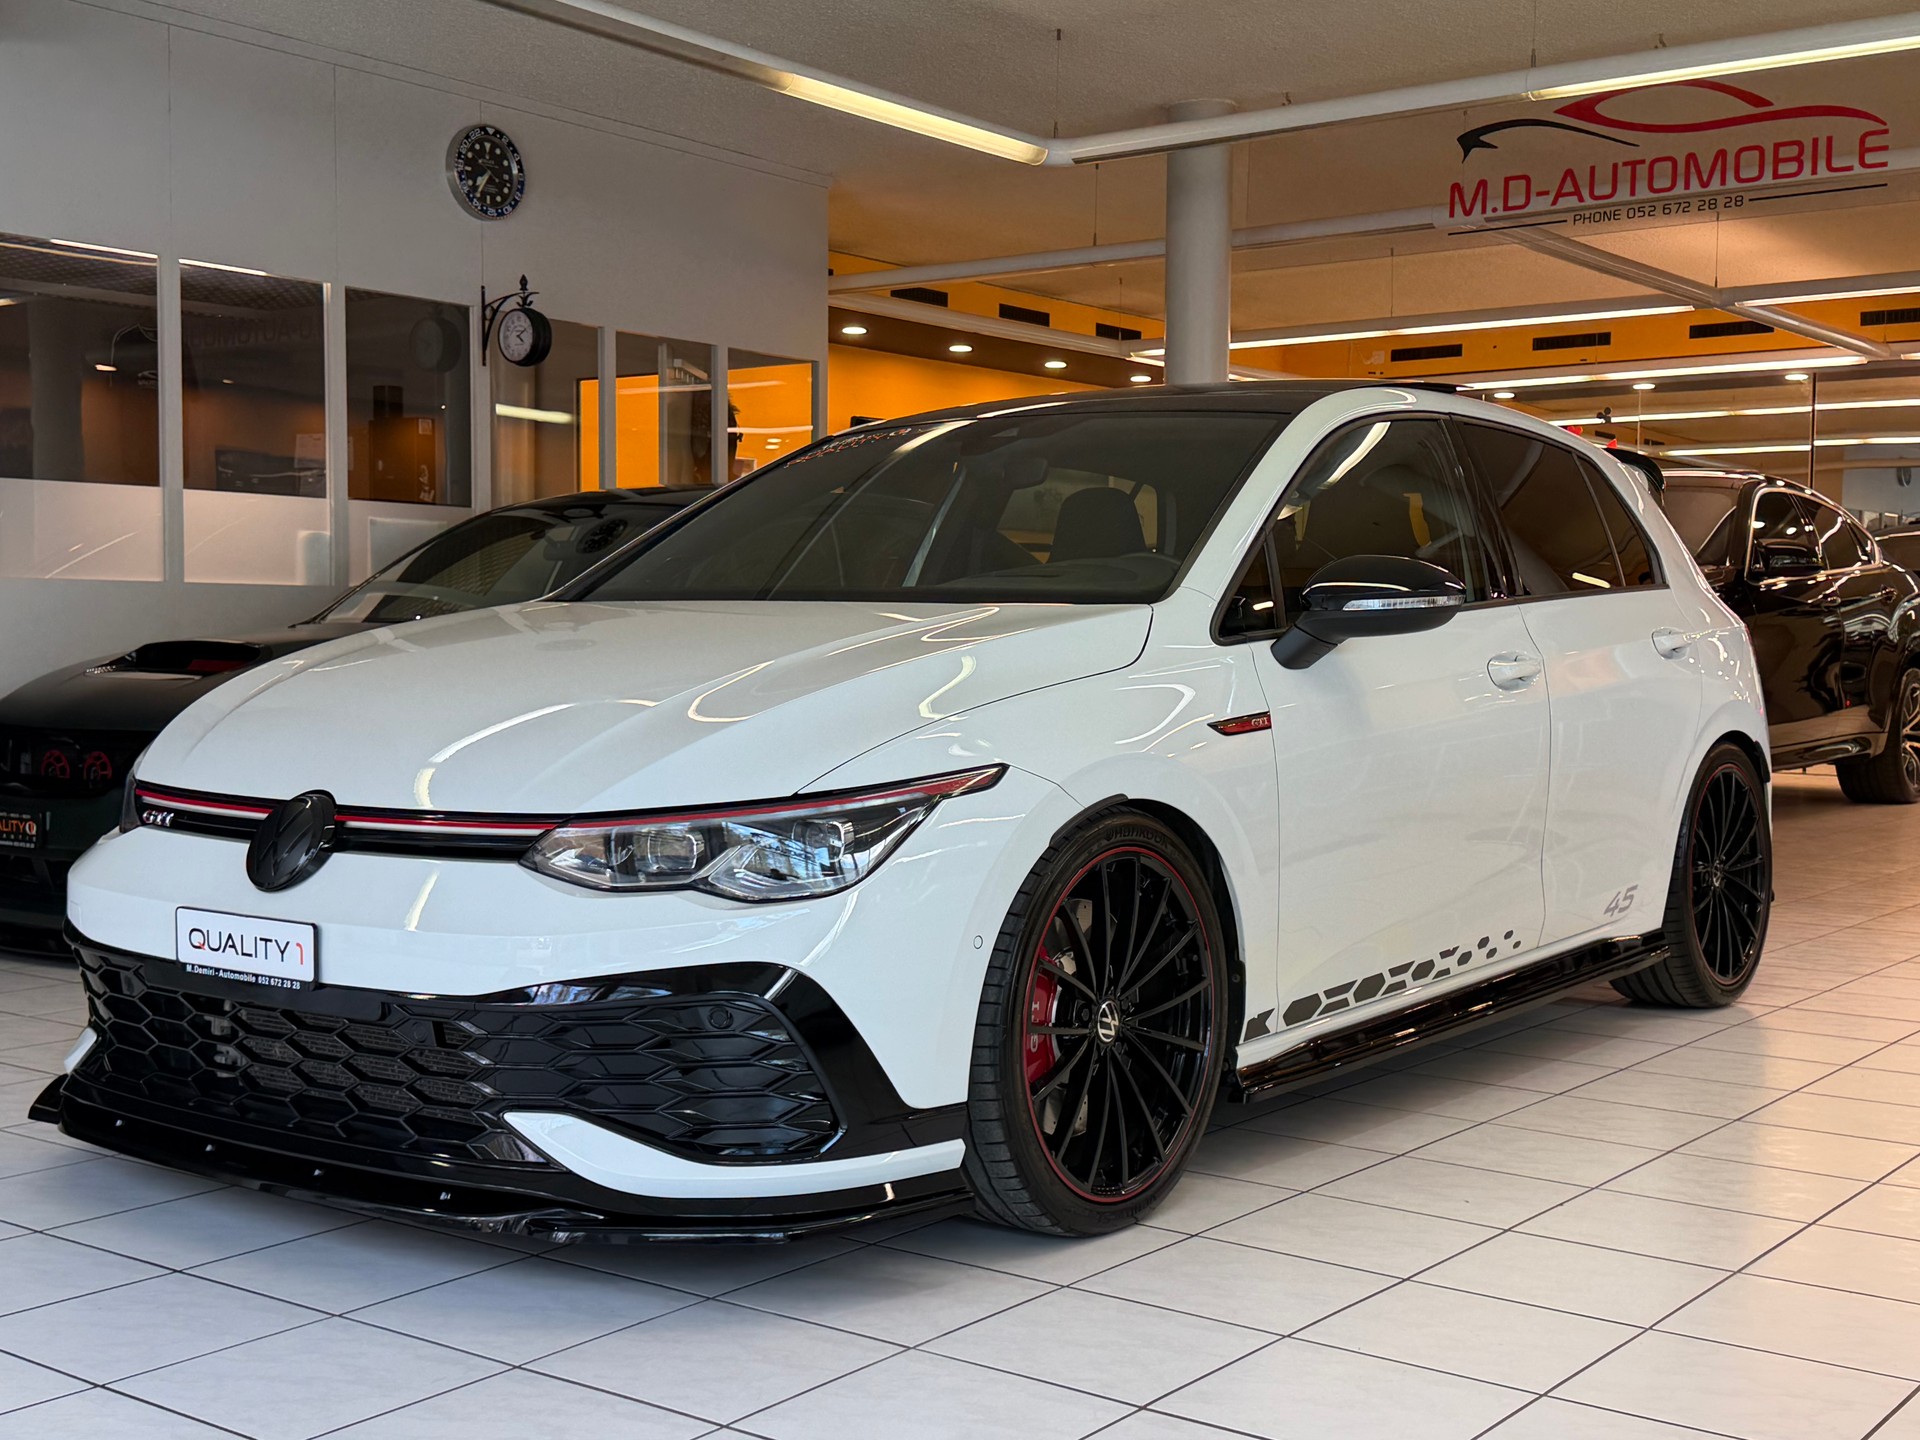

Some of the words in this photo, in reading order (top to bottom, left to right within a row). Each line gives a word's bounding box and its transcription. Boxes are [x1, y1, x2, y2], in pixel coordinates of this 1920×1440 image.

[1448, 128, 1889, 218] M.D-AUTOMOBILE
[1573, 208, 1622, 226] PHONE
[1626, 205, 1656, 220] 052
[1662, 201, 1691, 215] 672
[1697, 197, 1718, 212] 28
[1723, 194, 1744, 209] 28
[1251, 717, 1268, 727] GTI
[1603, 884, 1639, 918] 45
[188, 927, 290, 963] QUALITY
[296, 942, 304, 966] 1
[218, 969, 257, 984] Automobile
[270, 977, 282, 987] 672
[283, 979, 291, 988] 28
[292, 981, 301, 990] 28
